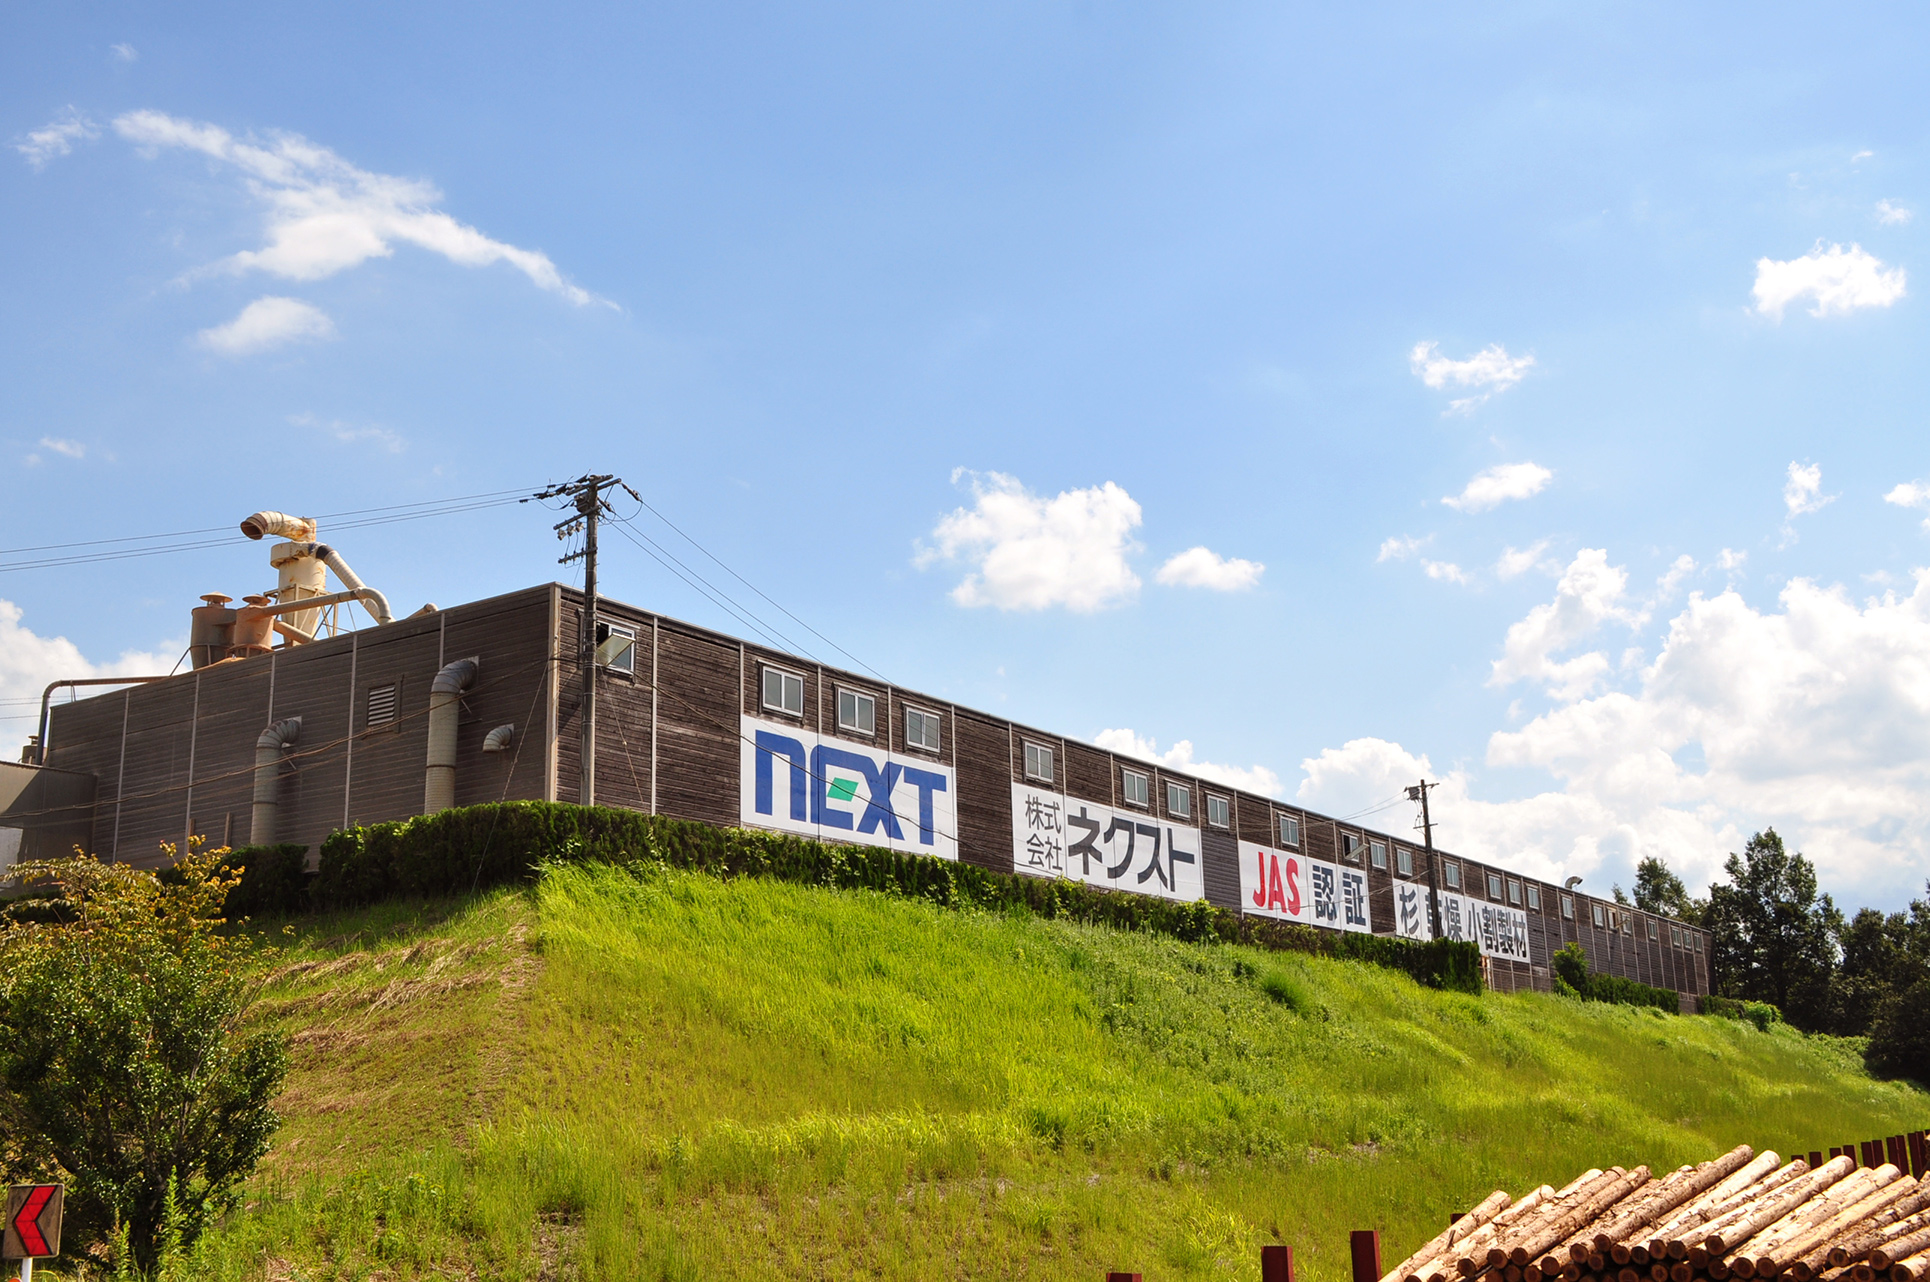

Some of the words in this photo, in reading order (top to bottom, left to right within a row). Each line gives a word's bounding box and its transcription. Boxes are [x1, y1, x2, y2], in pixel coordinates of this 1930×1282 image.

[1025, 794, 1062, 834] 株式
[1026, 833, 1063, 871] 会社
[1067, 806, 1195, 892] ネクスト
[1253, 851, 1301, 916] JAS
[1312, 864, 1366, 926] 認証
